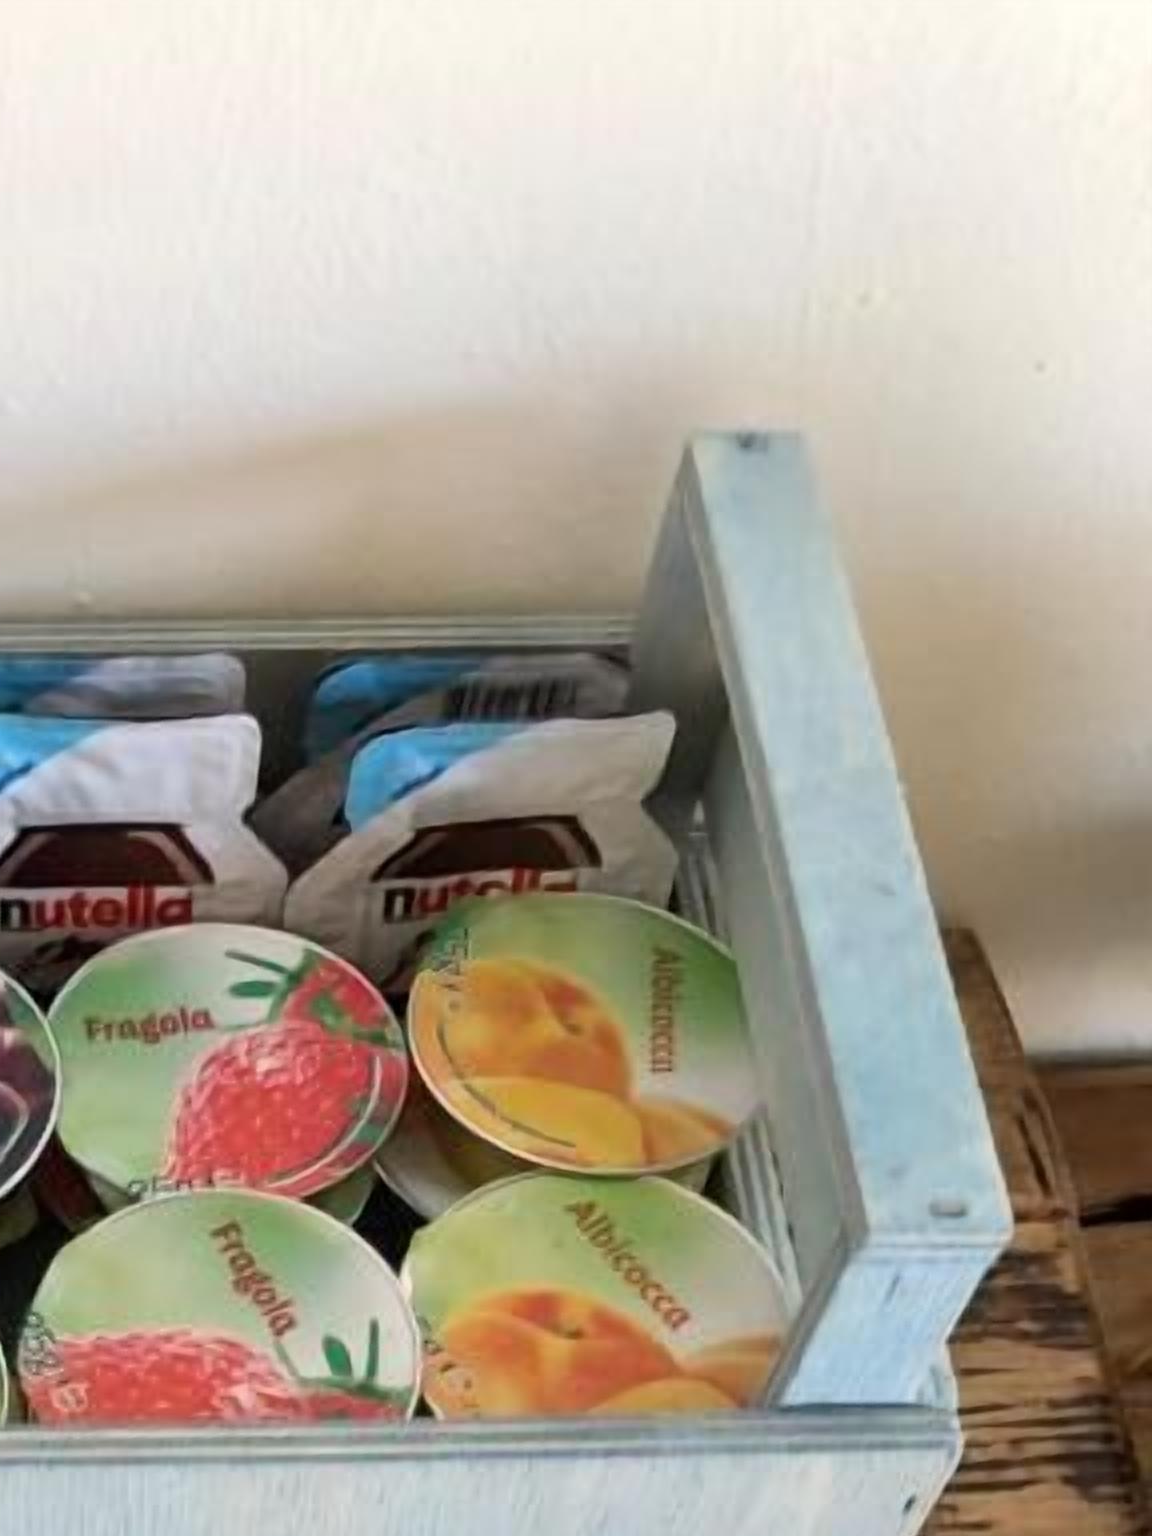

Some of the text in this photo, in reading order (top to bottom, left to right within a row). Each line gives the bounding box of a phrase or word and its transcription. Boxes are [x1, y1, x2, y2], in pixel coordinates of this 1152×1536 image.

[0, 883, 194, 931] nutella
[383, 866, 577, 924] nutll
[85, 1006, 216, 1046] Fragola
[209, 1220, 298, 1339] Fragola
[564, 1199, 692, 1331] Albicocca
